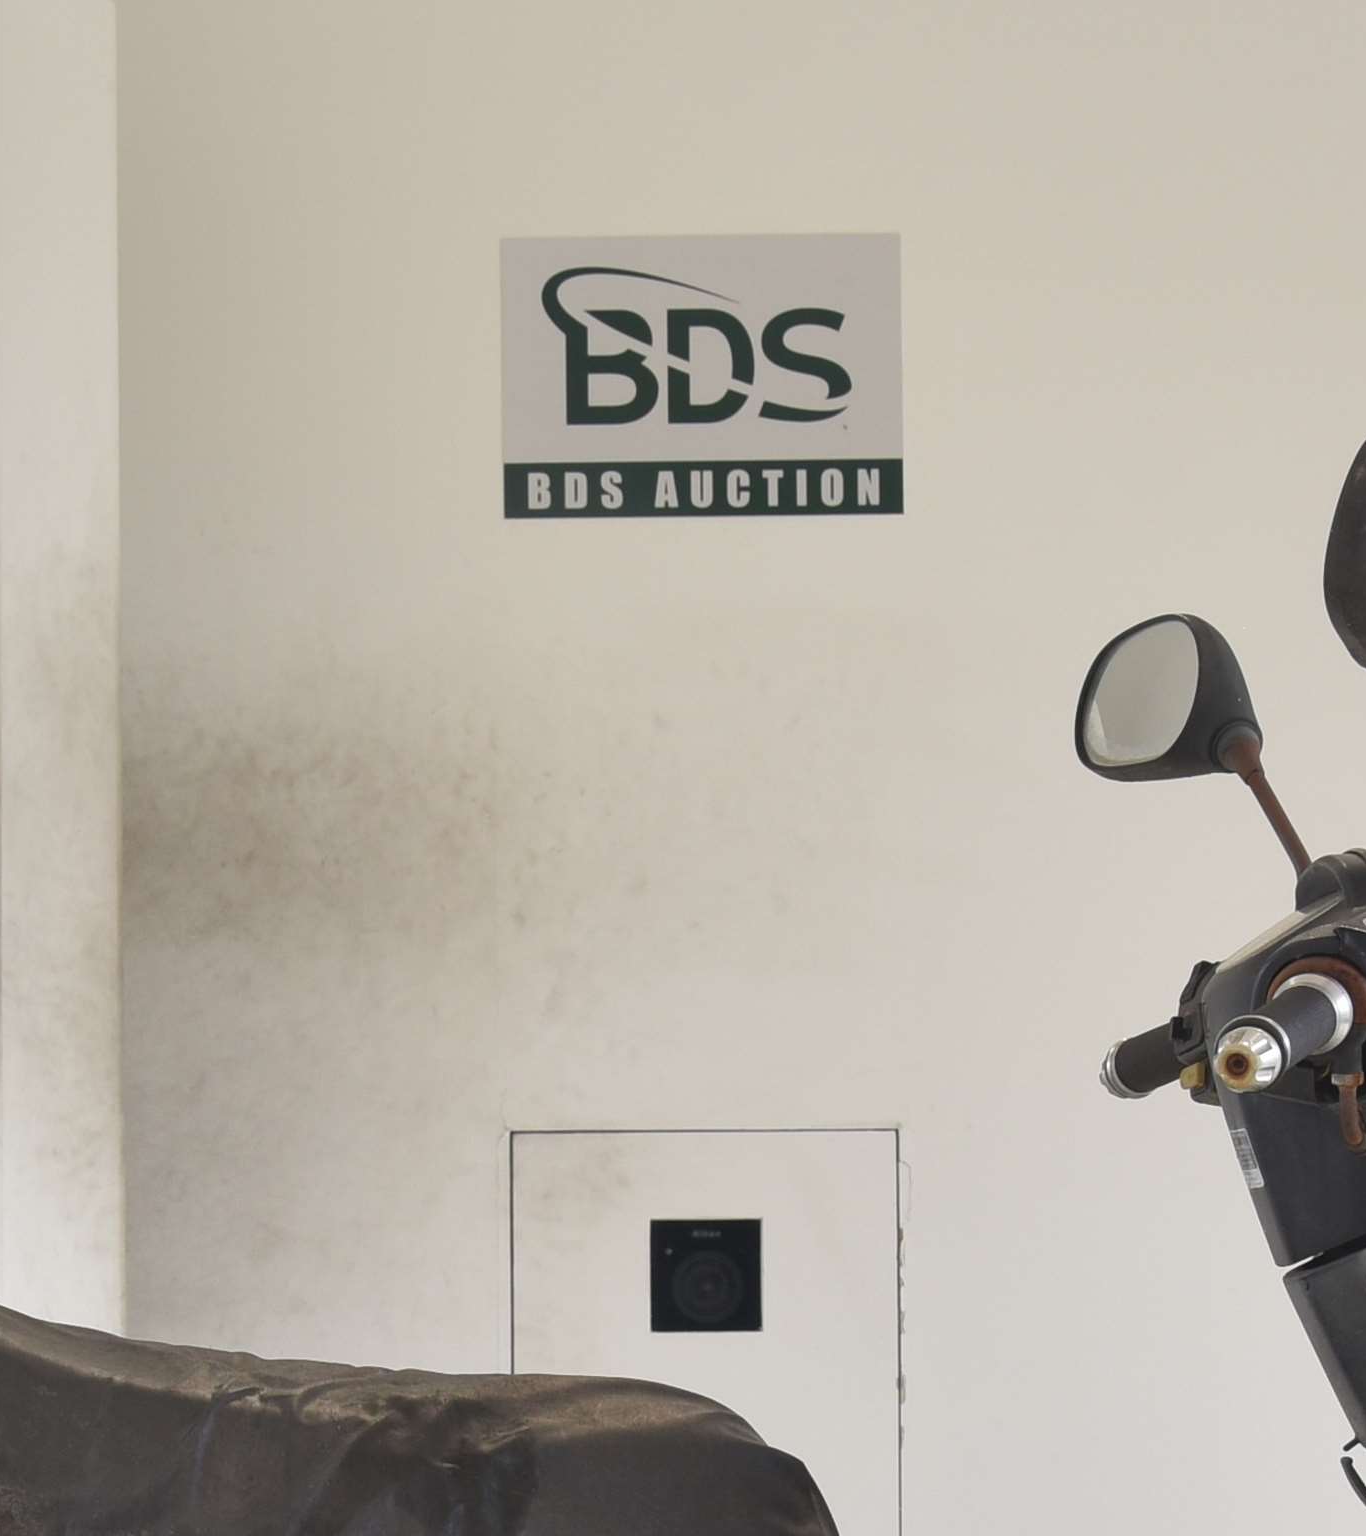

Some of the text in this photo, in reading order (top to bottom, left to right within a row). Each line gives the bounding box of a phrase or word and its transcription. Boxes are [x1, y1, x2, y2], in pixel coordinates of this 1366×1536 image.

[542, 267, 853, 425] BDS
[527, 468, 881, 510] BDS AUCTION
